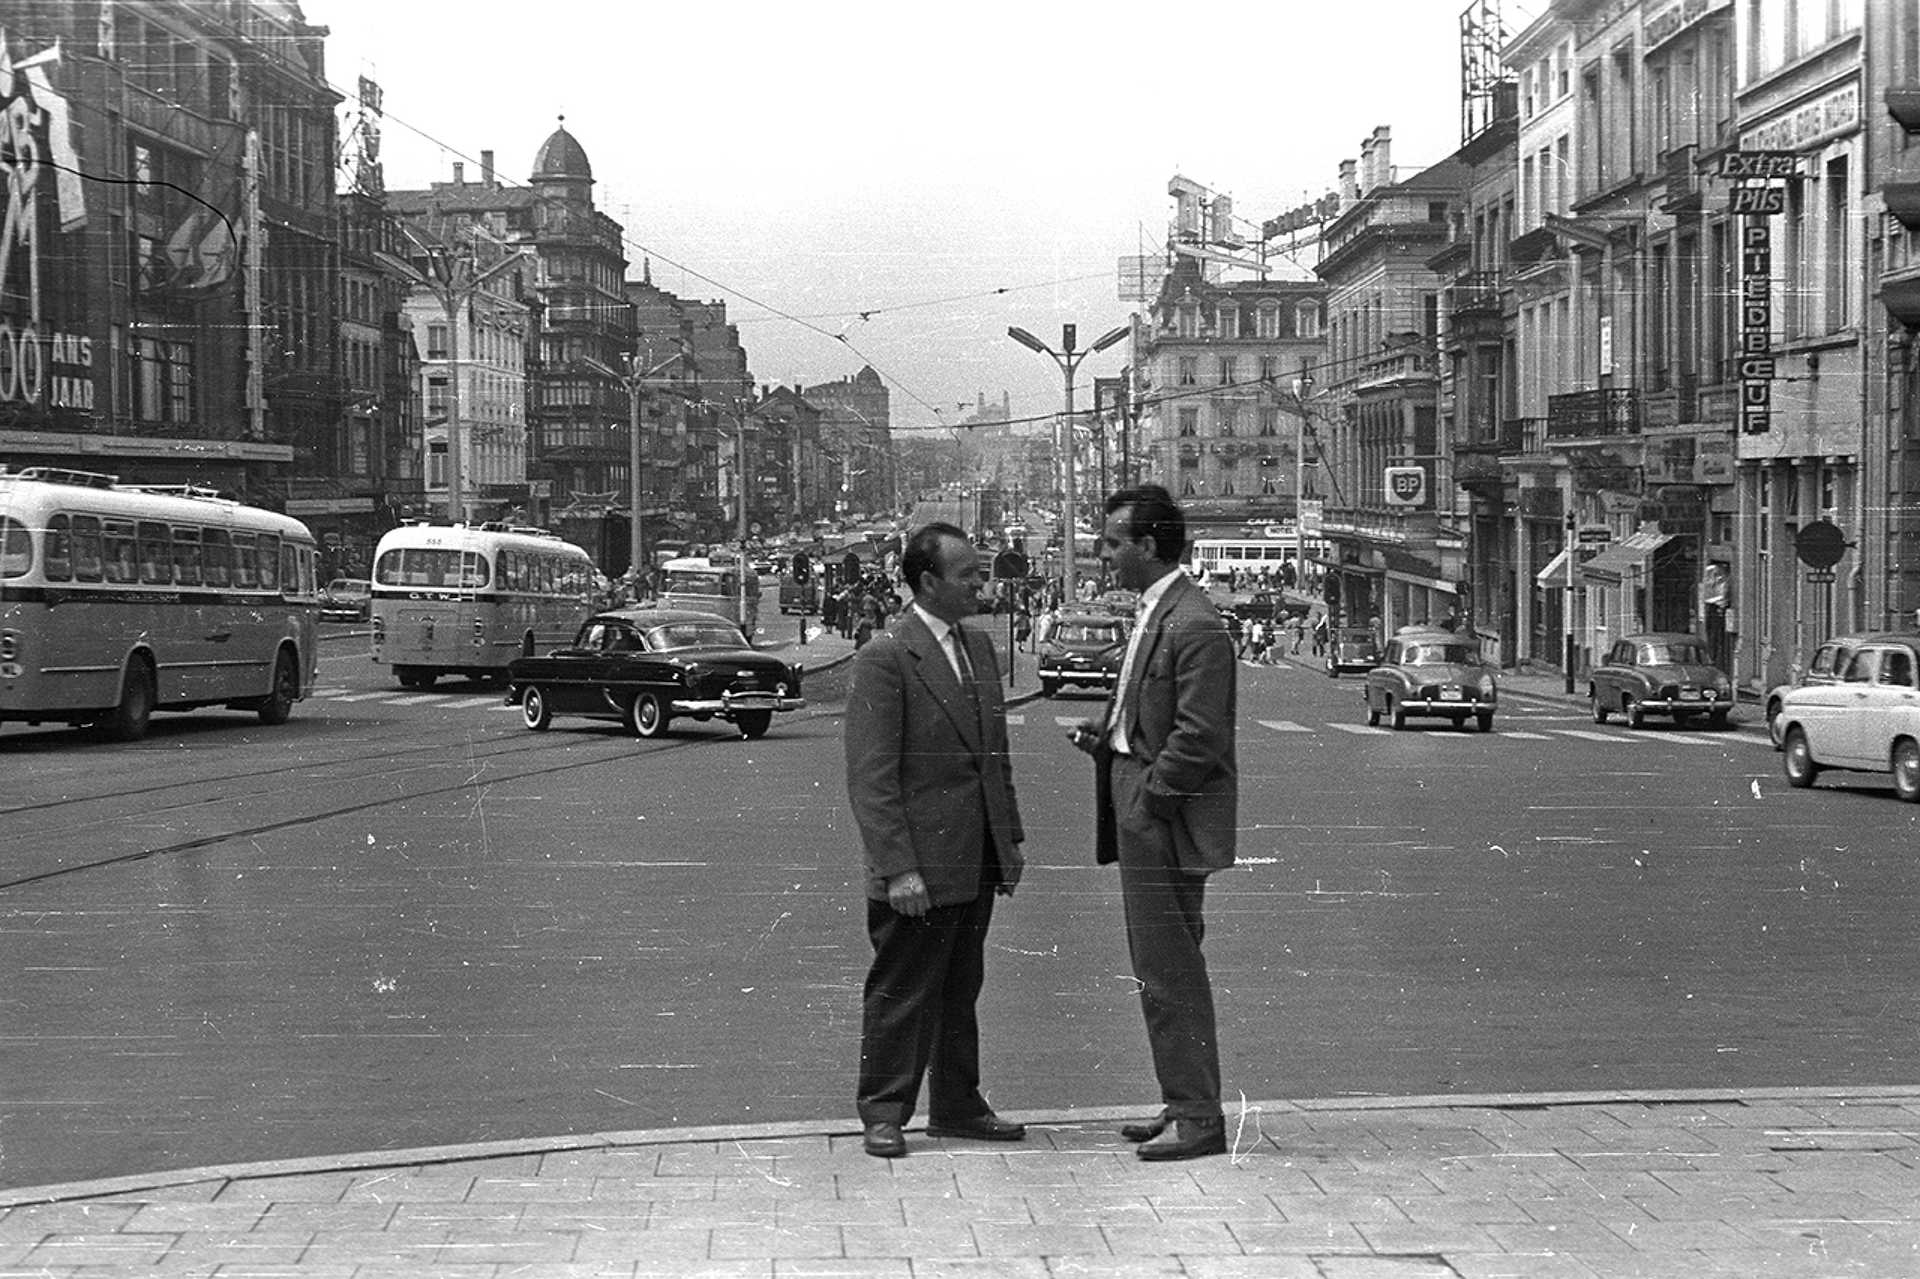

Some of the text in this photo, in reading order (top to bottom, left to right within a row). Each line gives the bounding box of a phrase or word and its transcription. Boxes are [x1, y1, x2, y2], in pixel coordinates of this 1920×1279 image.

[1721, 152, 1794, 175] Extra
[1733, 189, 1782, 212] Pils
[52, 332, 92, 367] ANS
[50, 376, 94, 409] JAAR
[1397, 477, 1418, 492] BP
